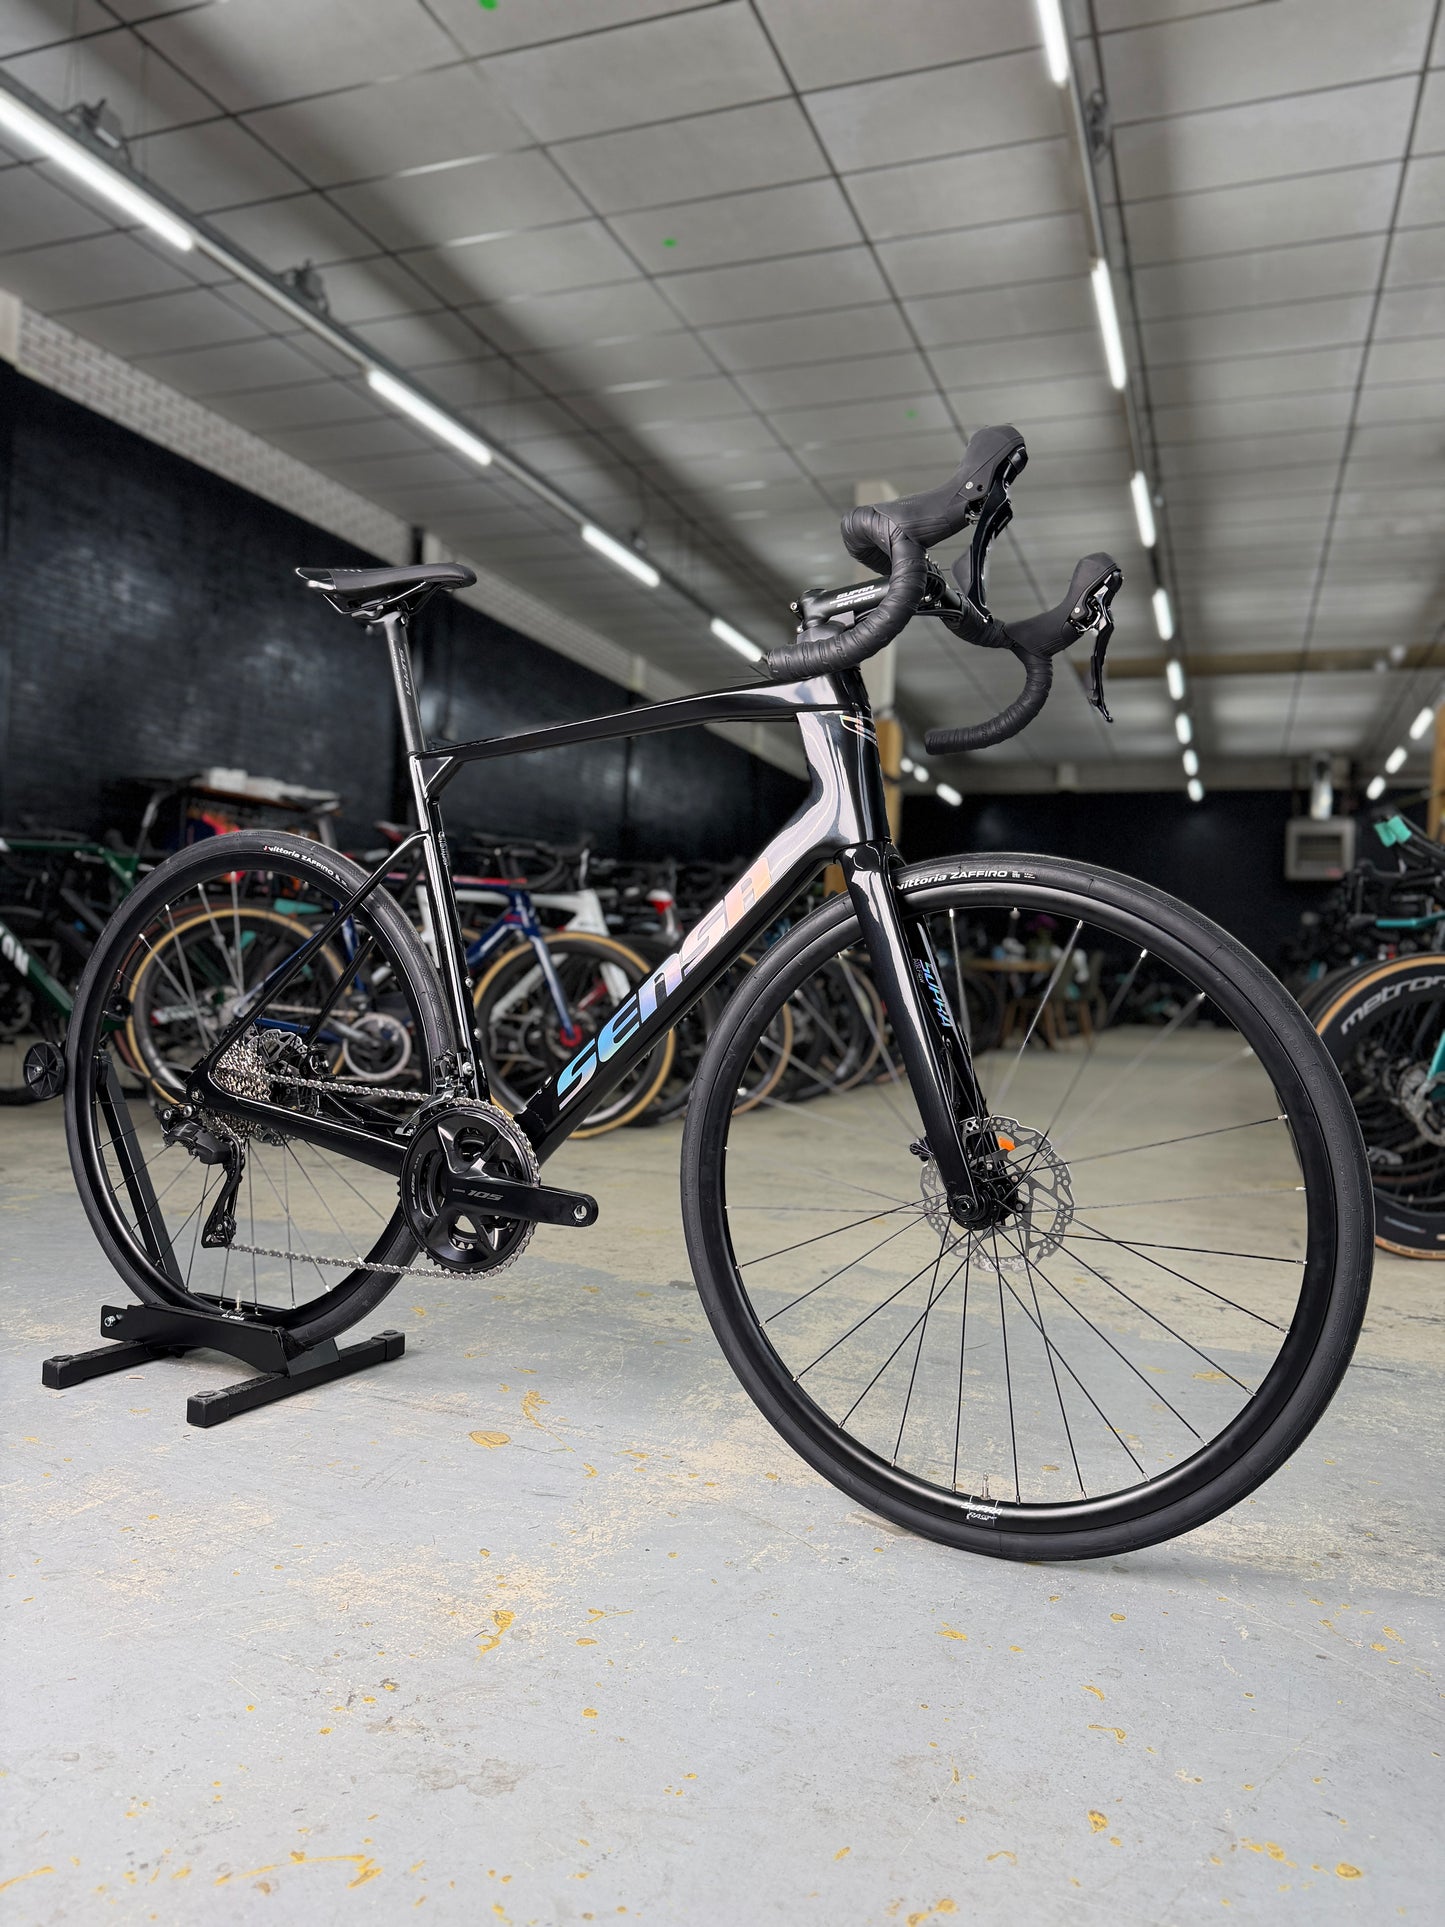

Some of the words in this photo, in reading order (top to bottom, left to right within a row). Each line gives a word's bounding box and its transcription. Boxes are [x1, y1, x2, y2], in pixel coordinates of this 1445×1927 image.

[950, 870, 1008, 880] ZAFFIRO
[920, 959, 954, 1027] SUPRA
[467, 1189, 504, 1201] 105
[960, 1502, 1004, 1515] SUPRA
